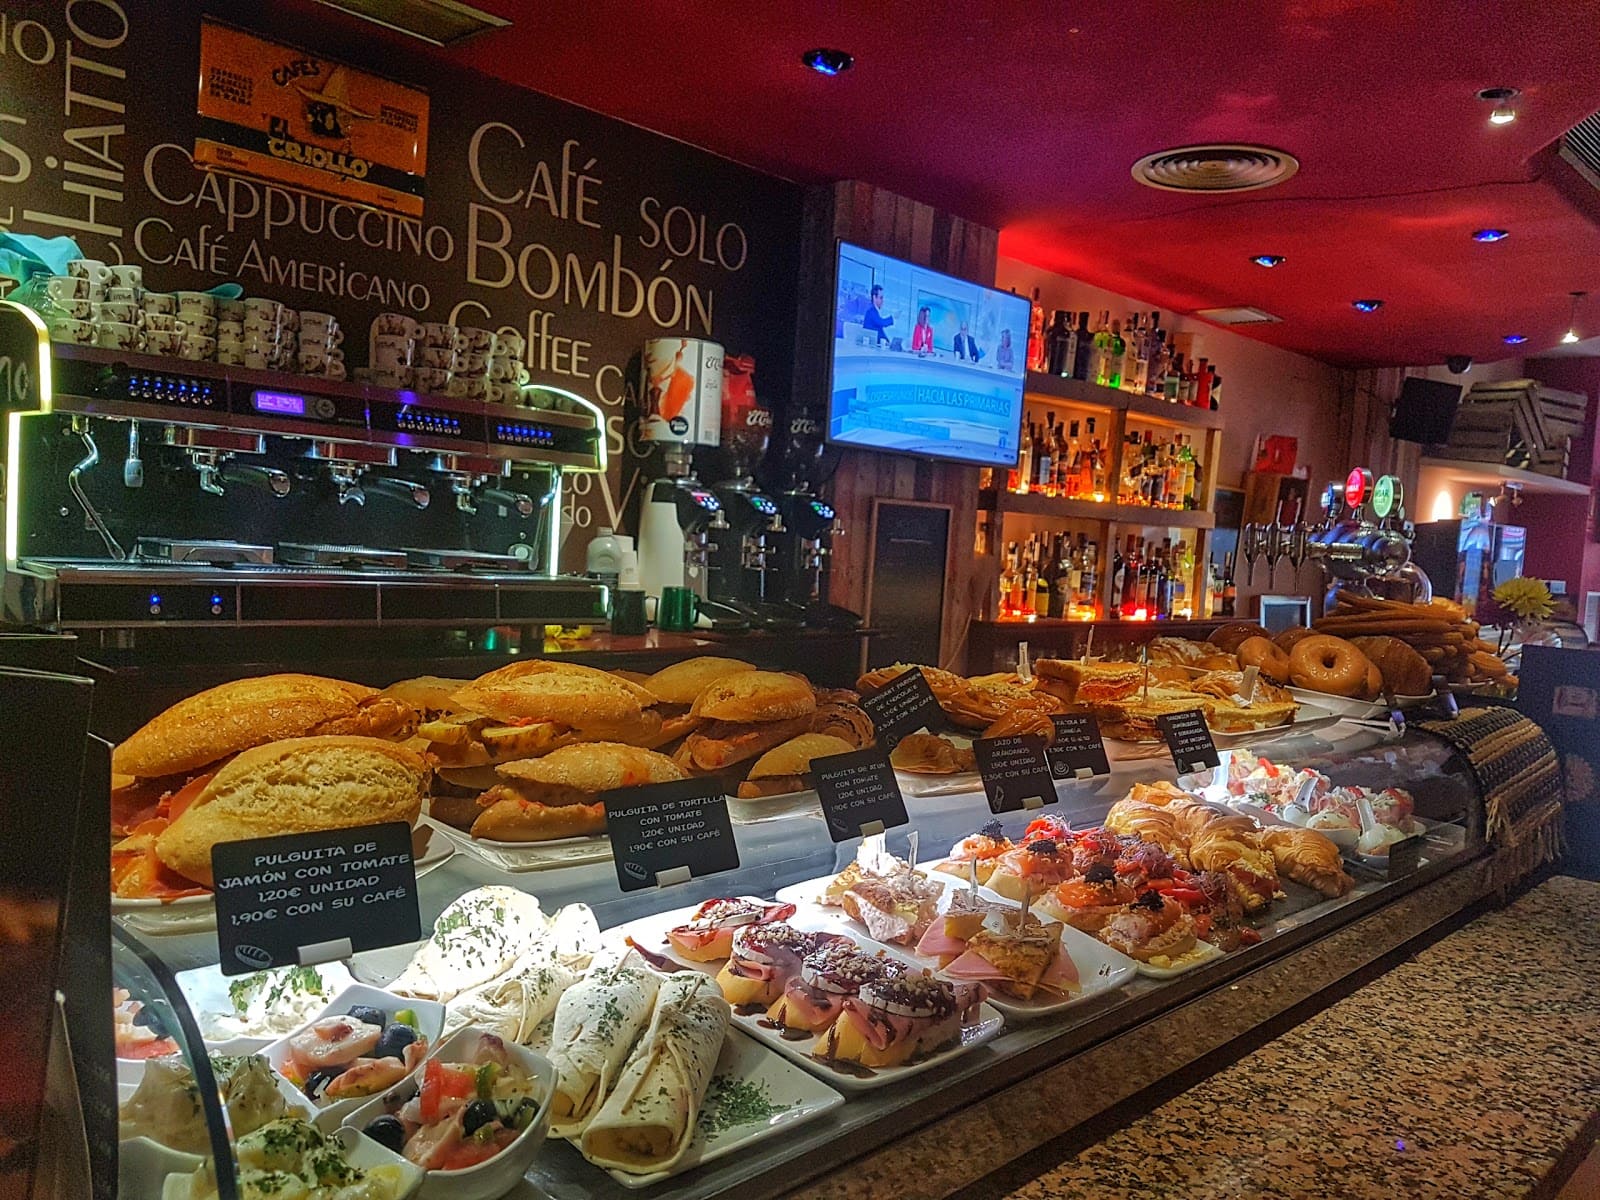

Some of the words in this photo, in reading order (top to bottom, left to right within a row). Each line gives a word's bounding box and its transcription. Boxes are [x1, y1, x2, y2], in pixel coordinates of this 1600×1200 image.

[143, 143, 454, 262] CAPPUCCINO
[638, 197, 747, 271] SOLO
[918, 388, 946, 404] HACIA
[835, 780, 850, 789] CON
[852, 774, 879, 785] TOMATE
[1005, 770, 1019, 778] CON
[856, 784, 883, 795] UNIDAD
[608, 804, 659, 819] PULGUITA
[662, 802, 676, 811] DE
[680, 795, 725, 808] TORTILLA
[850, 799, 865, 808] CON
[867, 796, 876, 804] SU
[640, 817, 660, 826] CON
[664, 809, 702, 822] TOMATE
[668, 821, 705, 833] UNIDAD
[657, 838, 677, 848] CON
[681, 835, 694, 843] SU
[697, 828, 721, 840] CAFÉ
[255, 846, 346, 866] PULGUITA
[353, 842, 377, 853] DE
[219, 870, 287, 889] JAMÓN
[294, 865, 332, 879] CON
[340, 854, 410, 873] TOMATE
[258, 887, 302, 903] 1,20€
[309, 875, 380, 895] UNIDAD
[231, 909, 278, 926] 1,90€
[285, 902, 324, 916] CON
[331, 897, 354, 909] SU
[362, 886, 407, 904] CAFÉ
